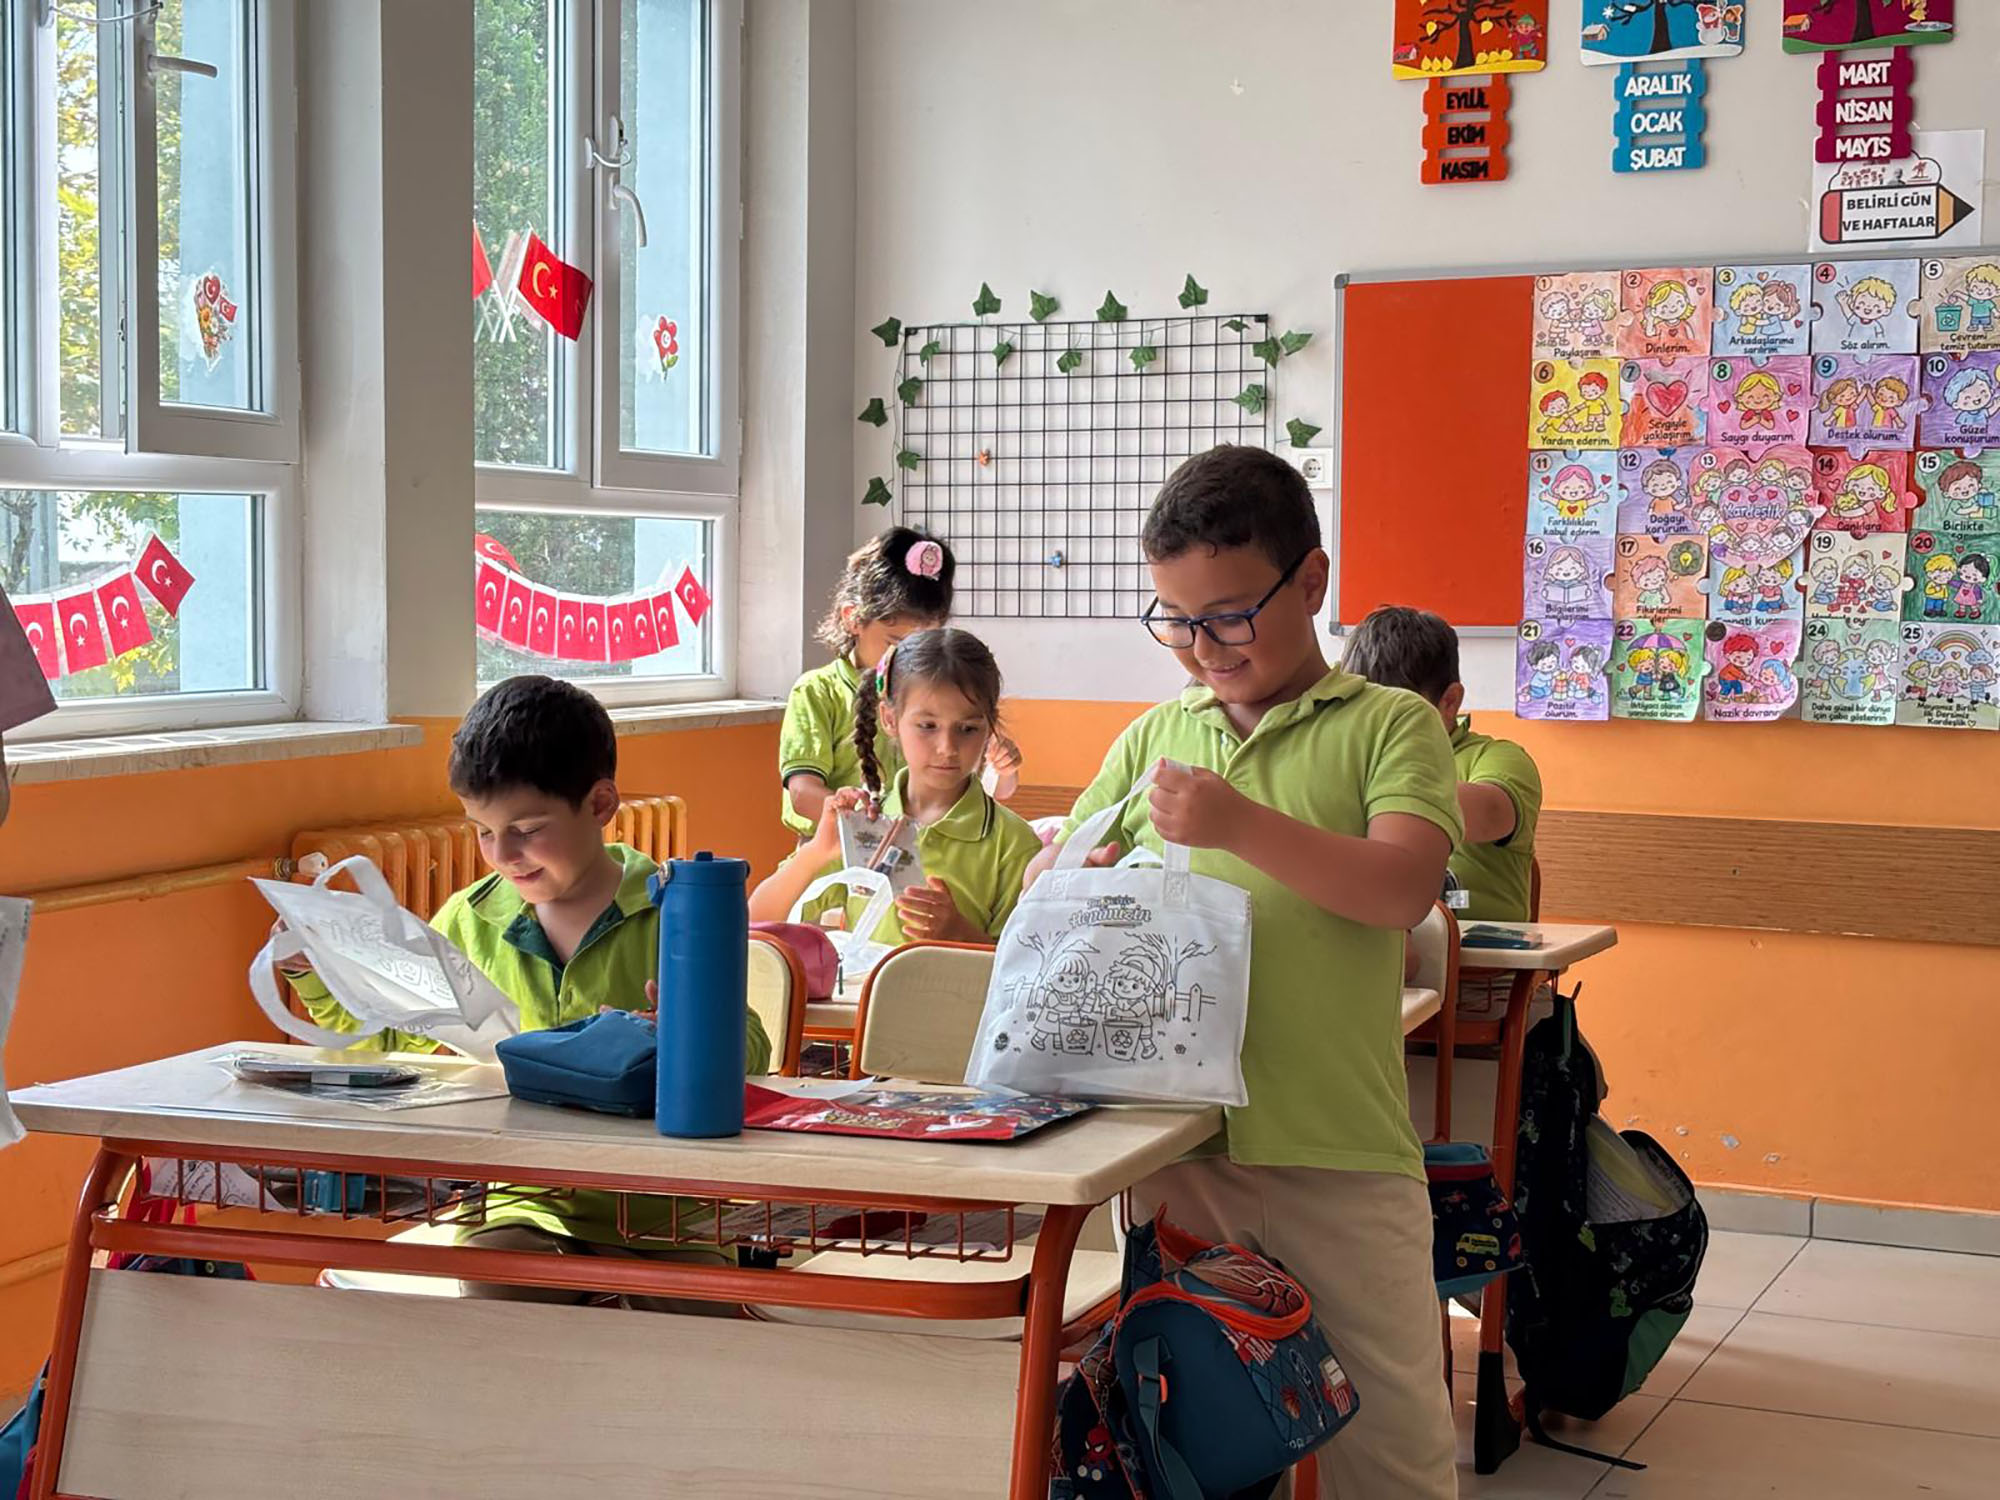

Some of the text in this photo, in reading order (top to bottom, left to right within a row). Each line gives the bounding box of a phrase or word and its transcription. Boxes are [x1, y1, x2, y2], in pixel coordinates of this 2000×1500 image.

[1839, 62, 1892, 86] MART
[1624, 74, 1692, 97] ARALIK
[1446, 87, 1489, 110] EYLÜL
[1835, 99, 1893, 123] NİSAN
[1630, 111, 1684, 133] OCAK
[1447, 123, 1486, 145] EKİM
[1835, 136, 1892, 159] MAYIS
[1630, 147, 1687, 170] ŞUBAT
[1441, 160, 1489, 180] KASIM
[1847, 192, 1932, 210] BELİRLİ GÜN
[1842, 215, 1936, 232] VE HAFTALAR
[1820, 267, 1830, 280] 4
[1929, 264, 1938, 276] 5
[1629, 273, 1638, 285] 2
[1723, 271, 1732, 283] 3
[1541, 279, 1547, 289] 1
[1840, 340, 1858, 350] Söz
[1539, 366, 1549, 379] 6
[1627, 366, 1636, 379] 7
[1717, 363, 1727, 379] 8
[1821, 359, 1832, 373] 9
[1928, 359, 1945, 373] 10
[1827, 429, 1860, 440] Destek
[1960, 425, 1988, 435] Güzel
[1541, 436, 1573, 446] Yardım
[1721, 432, 1749, 445] Saygı
[1535, 458, 1548, 469] 11
[1622, 454, 1637, 467] 12
[1703, 455, 1714, 466] 13
[1818, 457, 1834, 471] 14
[1921, 456, 1936, 470] 15
[1723, 503, 1783, 521] Kardeşlik
[1650, 515, 1685, 526] Doğayı
[1942, 520, 1984, 531] Birlikte
[1529, 541, 1543, 555] 16
[1620, 541, 1635, 554] 17
[1816, 536, 1832, 549] 19
[1915, 536, 1933, 550] 20
[1523, 624, 1539, 638] 21
[1617, 624, 1634, 637] 22
[1808, 624, 1826, 637] 24
[1903, 626, 1921, 639] 25
[1714, 708, 1740, 718] Nazik
[1812, 702, 1831, 711] Daha
